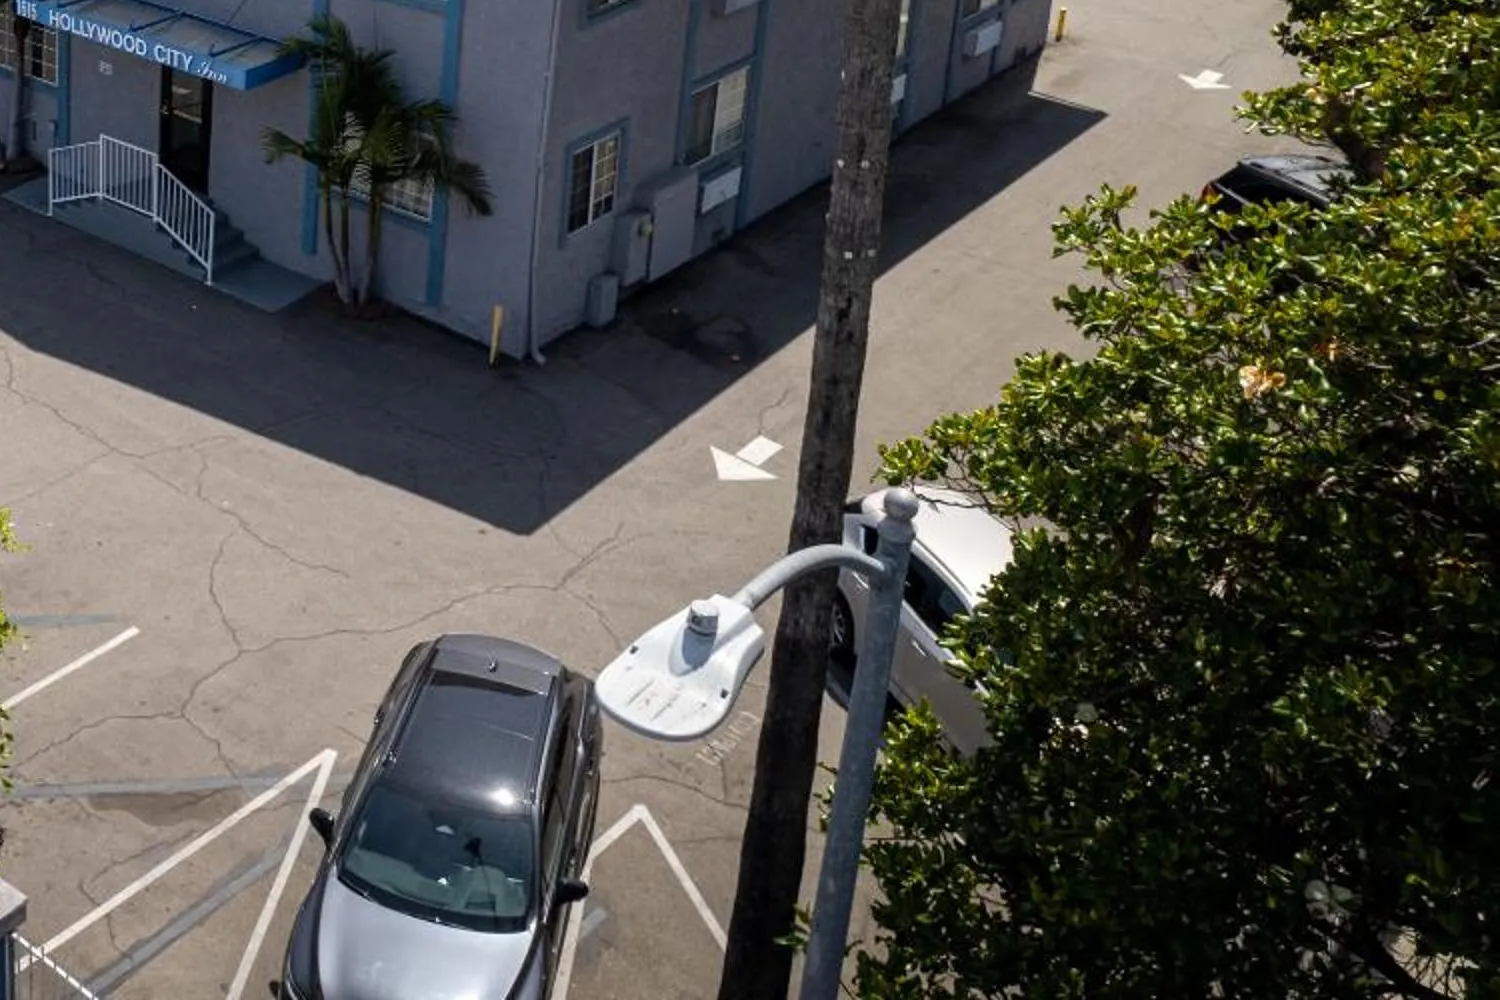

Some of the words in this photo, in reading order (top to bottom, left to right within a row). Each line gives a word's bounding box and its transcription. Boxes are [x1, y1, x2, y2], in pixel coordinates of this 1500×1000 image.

[48, 9, 148, 57] HOLLYWOOD
[154, 44, 194, 73] CITY
[197, 60, 228, 85] Inn
